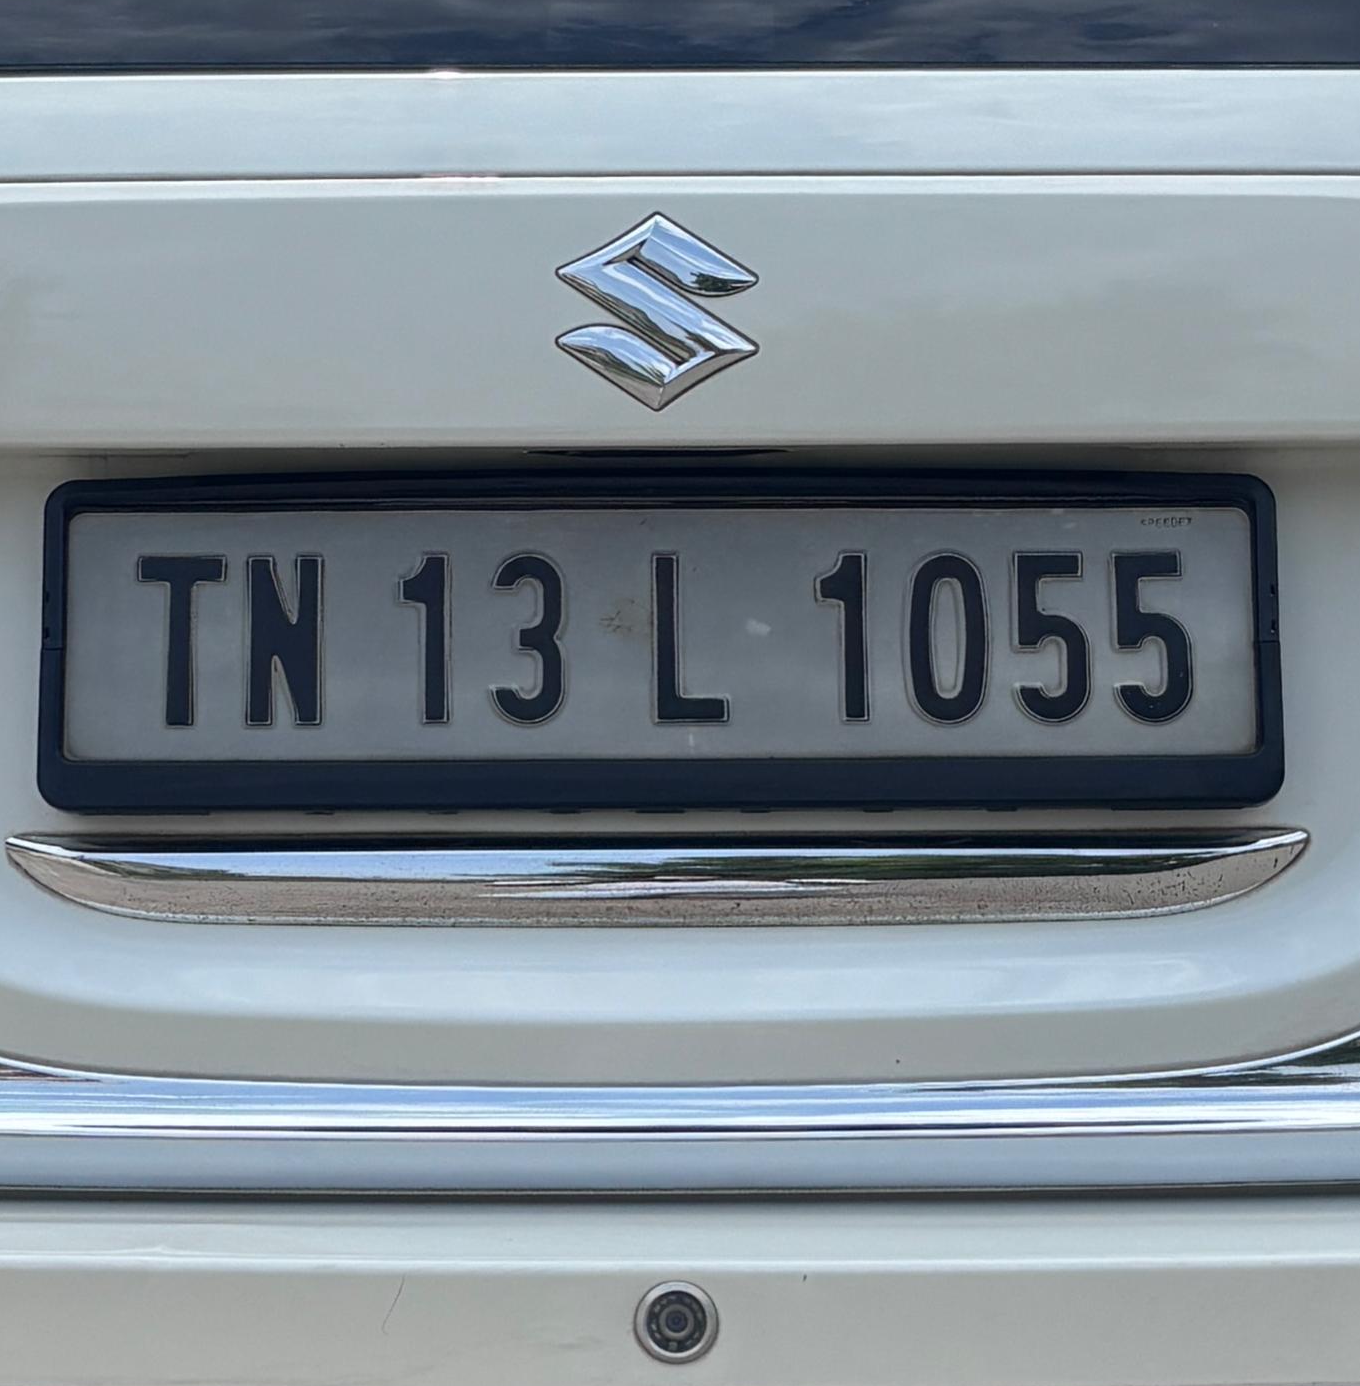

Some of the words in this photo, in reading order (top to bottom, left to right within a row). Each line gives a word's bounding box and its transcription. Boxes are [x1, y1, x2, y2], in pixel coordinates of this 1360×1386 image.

[138, 554, 324, 727] TN
[399, 553, 568, 725] 13
[652, 554, 730, 723] L
[815, 551, 1195, 725] 1055
